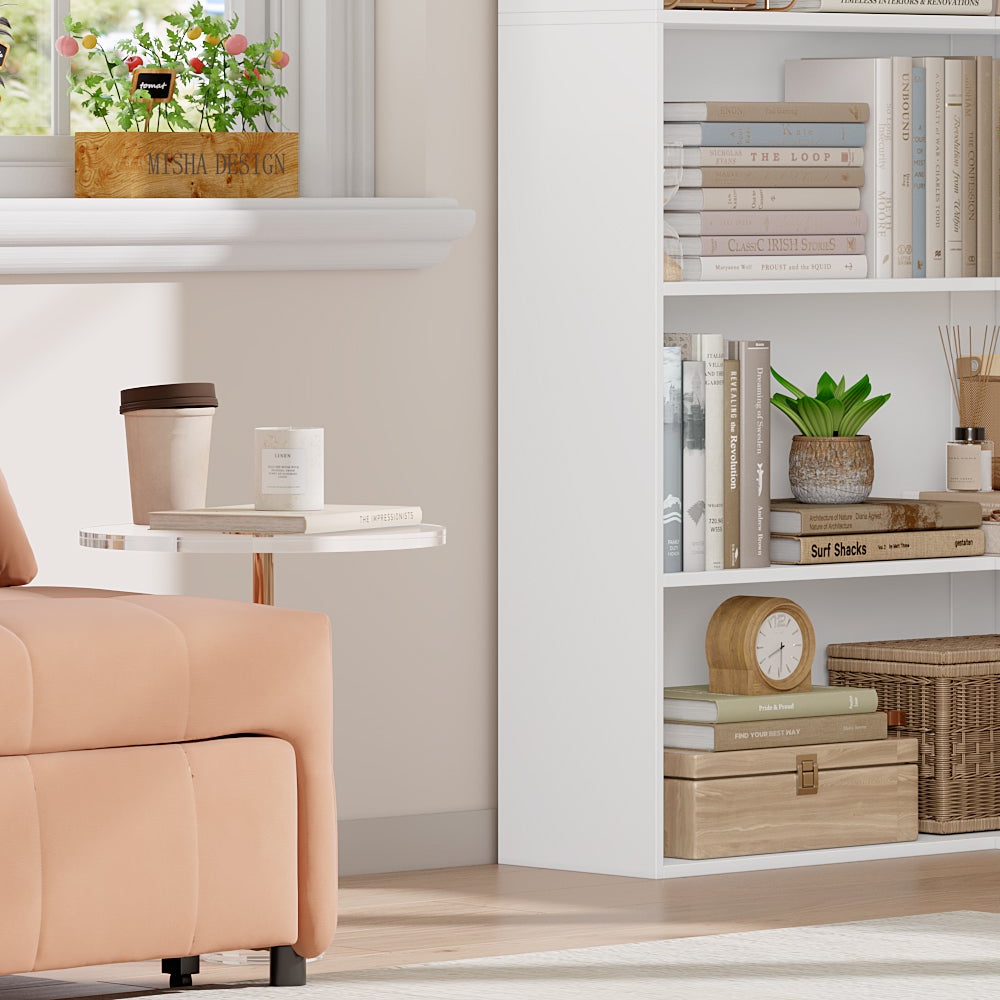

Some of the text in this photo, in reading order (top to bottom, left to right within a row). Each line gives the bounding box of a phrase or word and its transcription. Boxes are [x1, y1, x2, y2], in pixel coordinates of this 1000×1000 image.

[148, 152, 286, 175] MISHA DESIGN
[751, 153, 831, 161] THE LOOP
[952, 115, 961, 233] Revolution from Within
[767, 238, 798, 251] IRISH
[755, 367, 763, 409] Dreaming
[757, 411, 763, 420] of
[729, 435, 738, 489] Revolution
[359, 511, 414, 525] THE IMPRESSIONISTS
[811, 543, 831, 558] Surf
[834, 542, 867, 557] Shacks
[955, 539, 974, 548] gestalten
[758, 704, 772, 712] Pride
[778, 703, 794, 711] Proud
